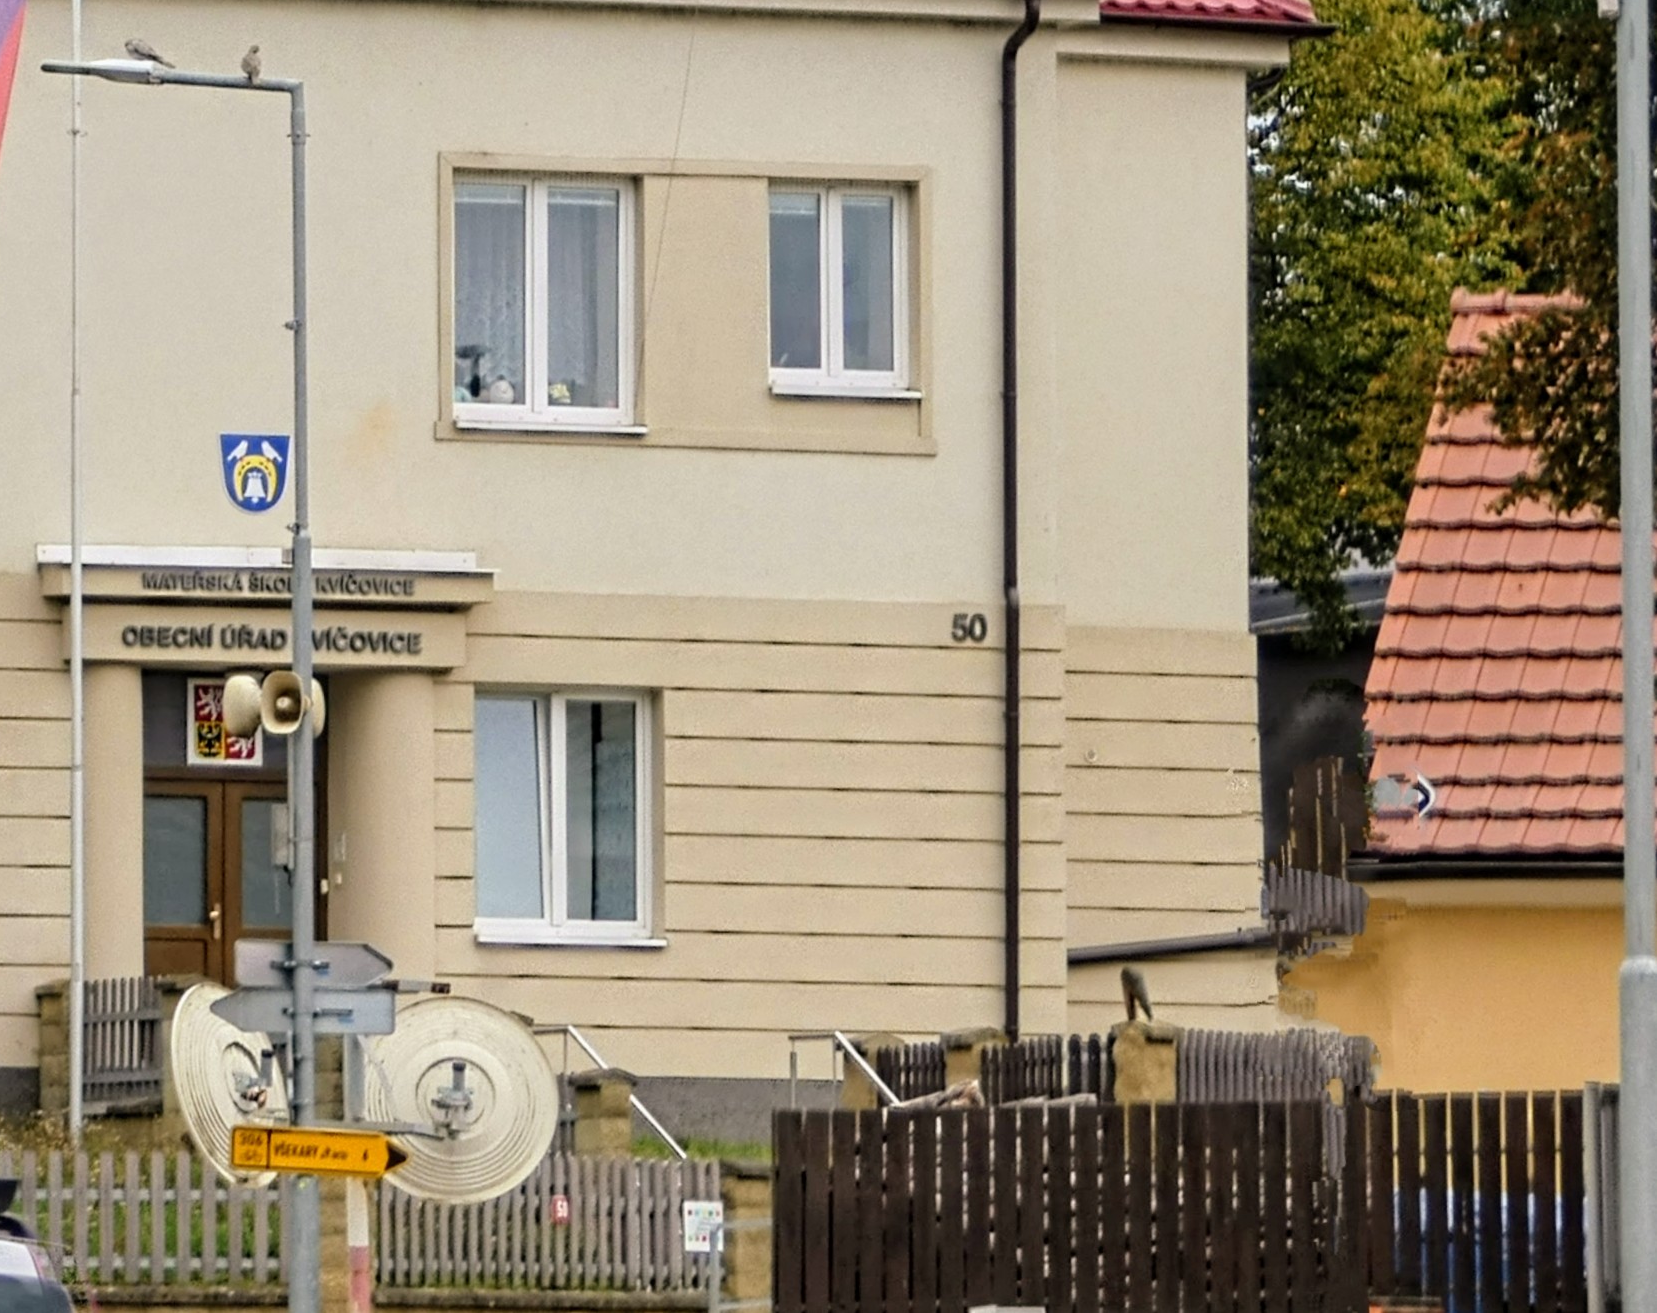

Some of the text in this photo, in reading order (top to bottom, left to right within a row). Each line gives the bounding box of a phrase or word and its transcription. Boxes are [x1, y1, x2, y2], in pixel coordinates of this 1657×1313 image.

[142, 571, 242, 592] MATEŘSKÁ
[248, 572, 292, 594] ŠKOL
[122, 623, 422, 655] OBECNÍ ÚŘAD VÍČOVICE
[951, 613, 987, 642] 50
